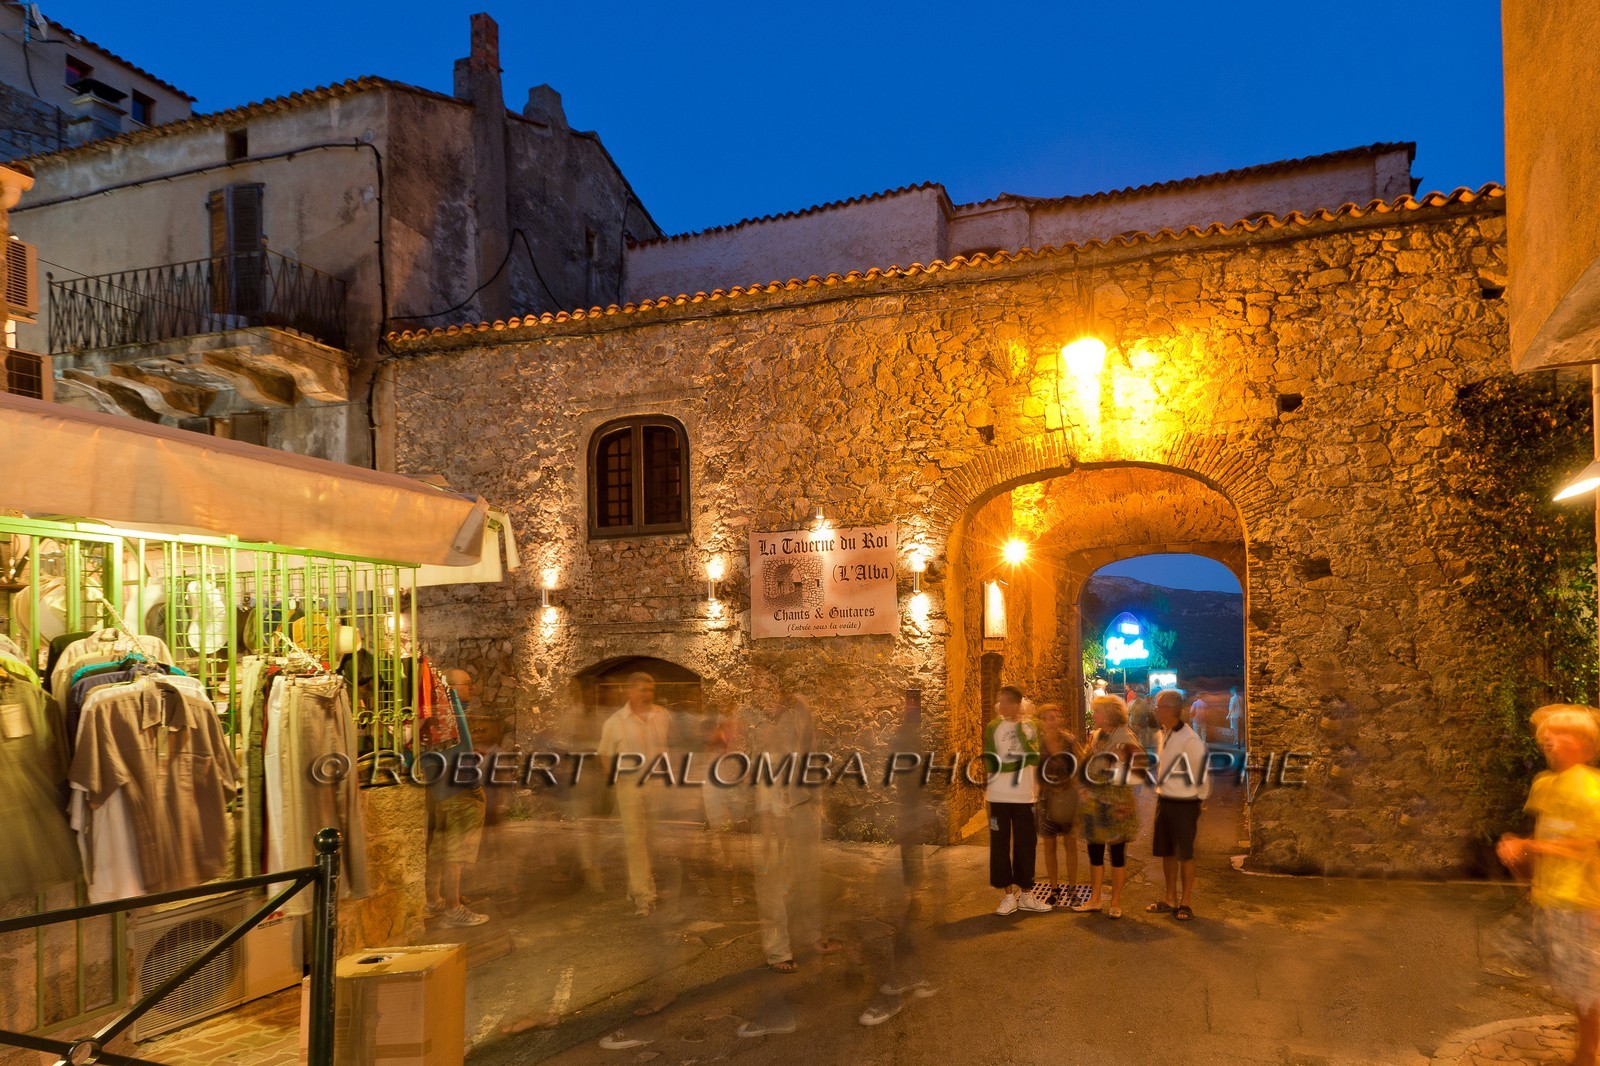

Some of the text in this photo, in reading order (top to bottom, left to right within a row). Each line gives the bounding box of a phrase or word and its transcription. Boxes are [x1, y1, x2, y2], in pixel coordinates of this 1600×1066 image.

[758, 532, 889, 556] La Taverne du Roi
[832, 562, 895, 584] (L'Alba)
[773, 606, 876, 622] Chants & Guitares
[787, 624, 811, 632] (Entrée
[829, 622, 838, 630] la
